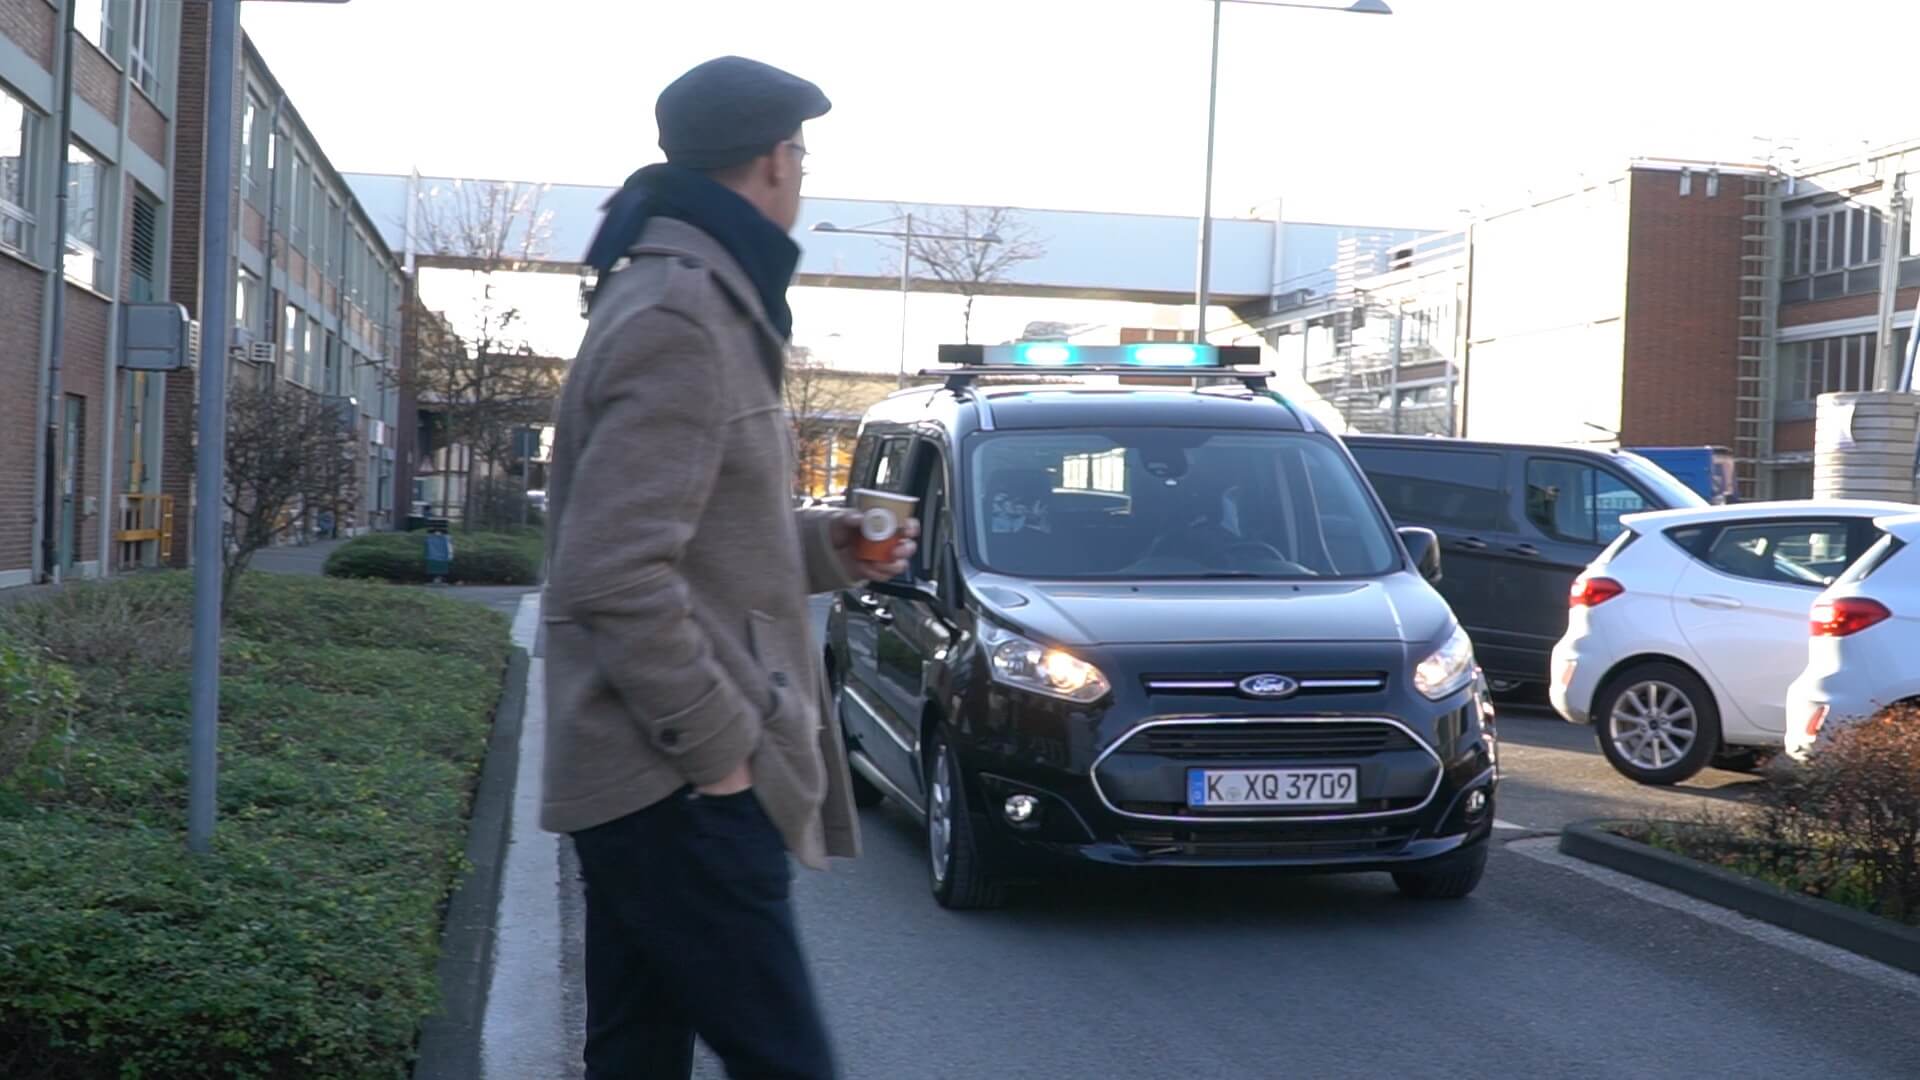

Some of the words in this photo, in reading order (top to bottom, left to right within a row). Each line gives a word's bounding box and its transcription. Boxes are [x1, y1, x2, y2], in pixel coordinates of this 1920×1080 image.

[1207, 775, 1223, 801] K
[1244, 774, 1278, 801] XQ
[1285, 772, 1353, 800] 3709
